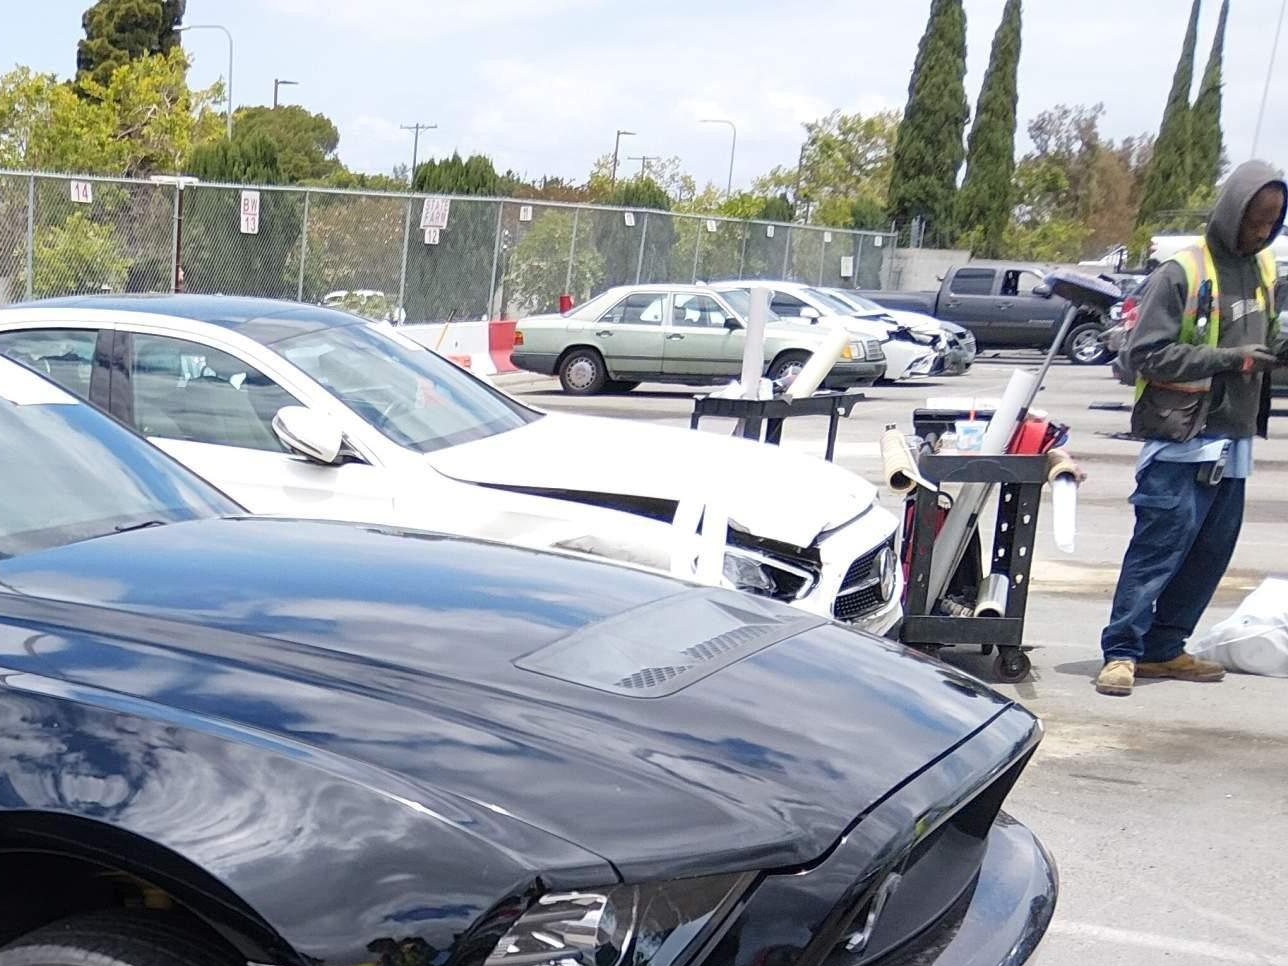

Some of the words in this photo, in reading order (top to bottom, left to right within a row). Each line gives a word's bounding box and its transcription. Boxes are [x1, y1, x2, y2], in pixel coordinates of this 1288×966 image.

[74, 183, 89, 201] 14
[245, 217, 256, 232] 13
[428, 230, 437, 243] 12
